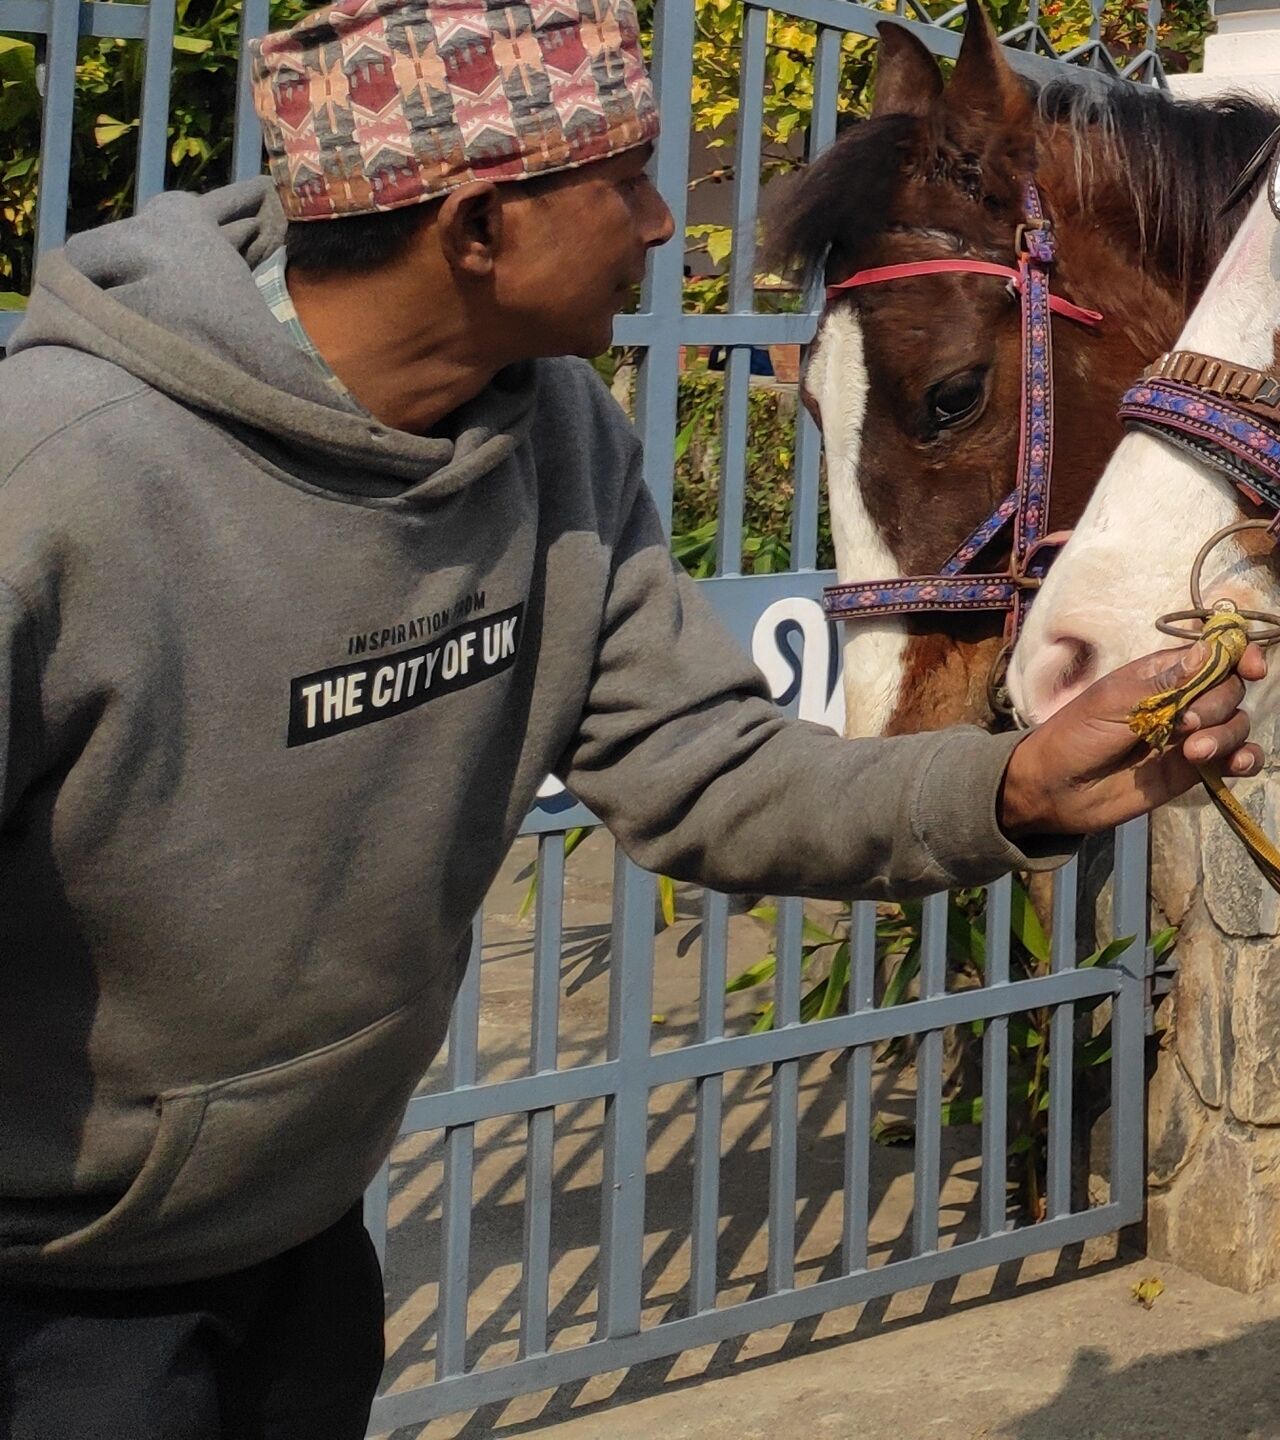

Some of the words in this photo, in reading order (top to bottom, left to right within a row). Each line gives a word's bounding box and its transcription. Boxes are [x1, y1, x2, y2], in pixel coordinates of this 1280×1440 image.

[302, 671, 367, 729] THE
[371, 647, 441, 709] CITY
[441, 631, 477, 681] OF
[483, 616, 518, 665] UK
[347, 609, 450, 656] INSPIRATION
